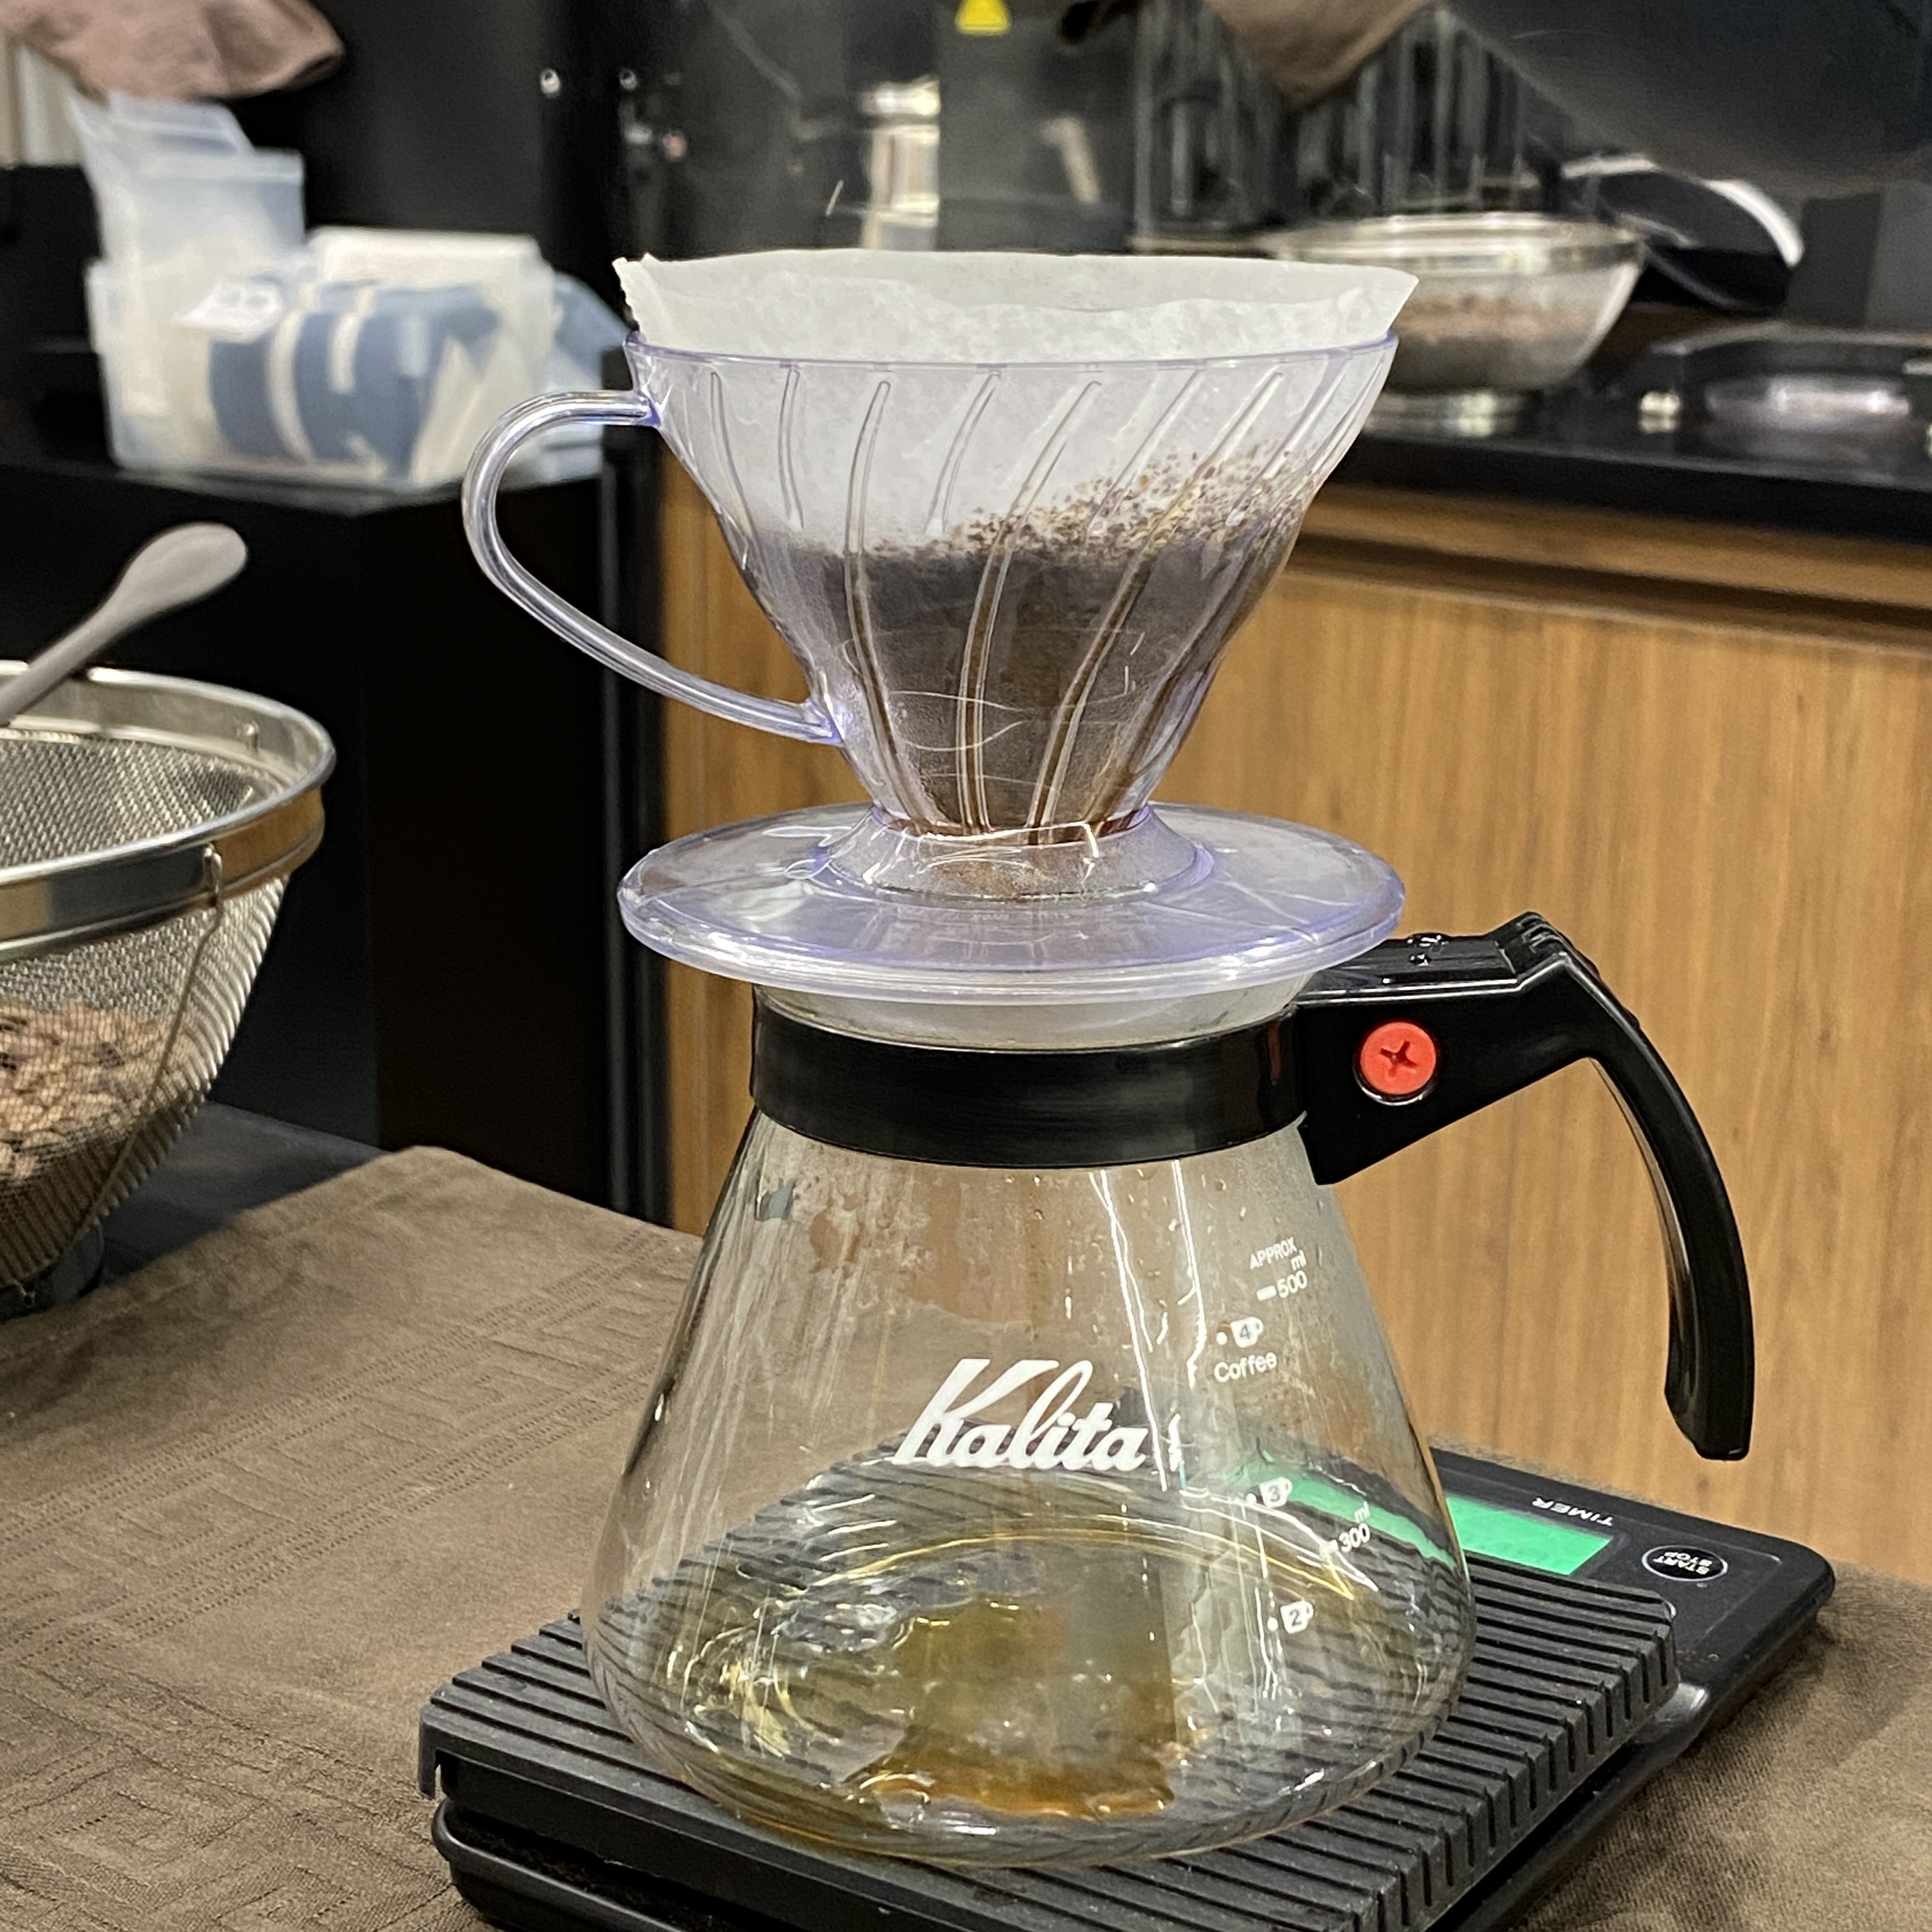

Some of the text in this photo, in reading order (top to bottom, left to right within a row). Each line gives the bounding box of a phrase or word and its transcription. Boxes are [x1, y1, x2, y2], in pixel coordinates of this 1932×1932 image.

[1250, 1237, 1297, 1269] APPROX
[1291, 1250, 1307, 1271] ml
[1276, 1270, 1308, 1298] 500
[1239, 1323, 1252, 1340] 4
[1214, 1352, 1277, 1382] Coffee
[892, 1358, 1148, 1471] Kalita
[1268, 1485, 1280, 1503] 3
[1354, 1501, 1370, 1523] ml
[1532, 1497, 1613, 1526] TIMER
[1339, 1523, 1370, 1552] 300
[1652, 1556, 1710, 1575] START
[1664, 1552, 1712, 1567] STOP
[1289, 1609, 1302, 1627] 2
